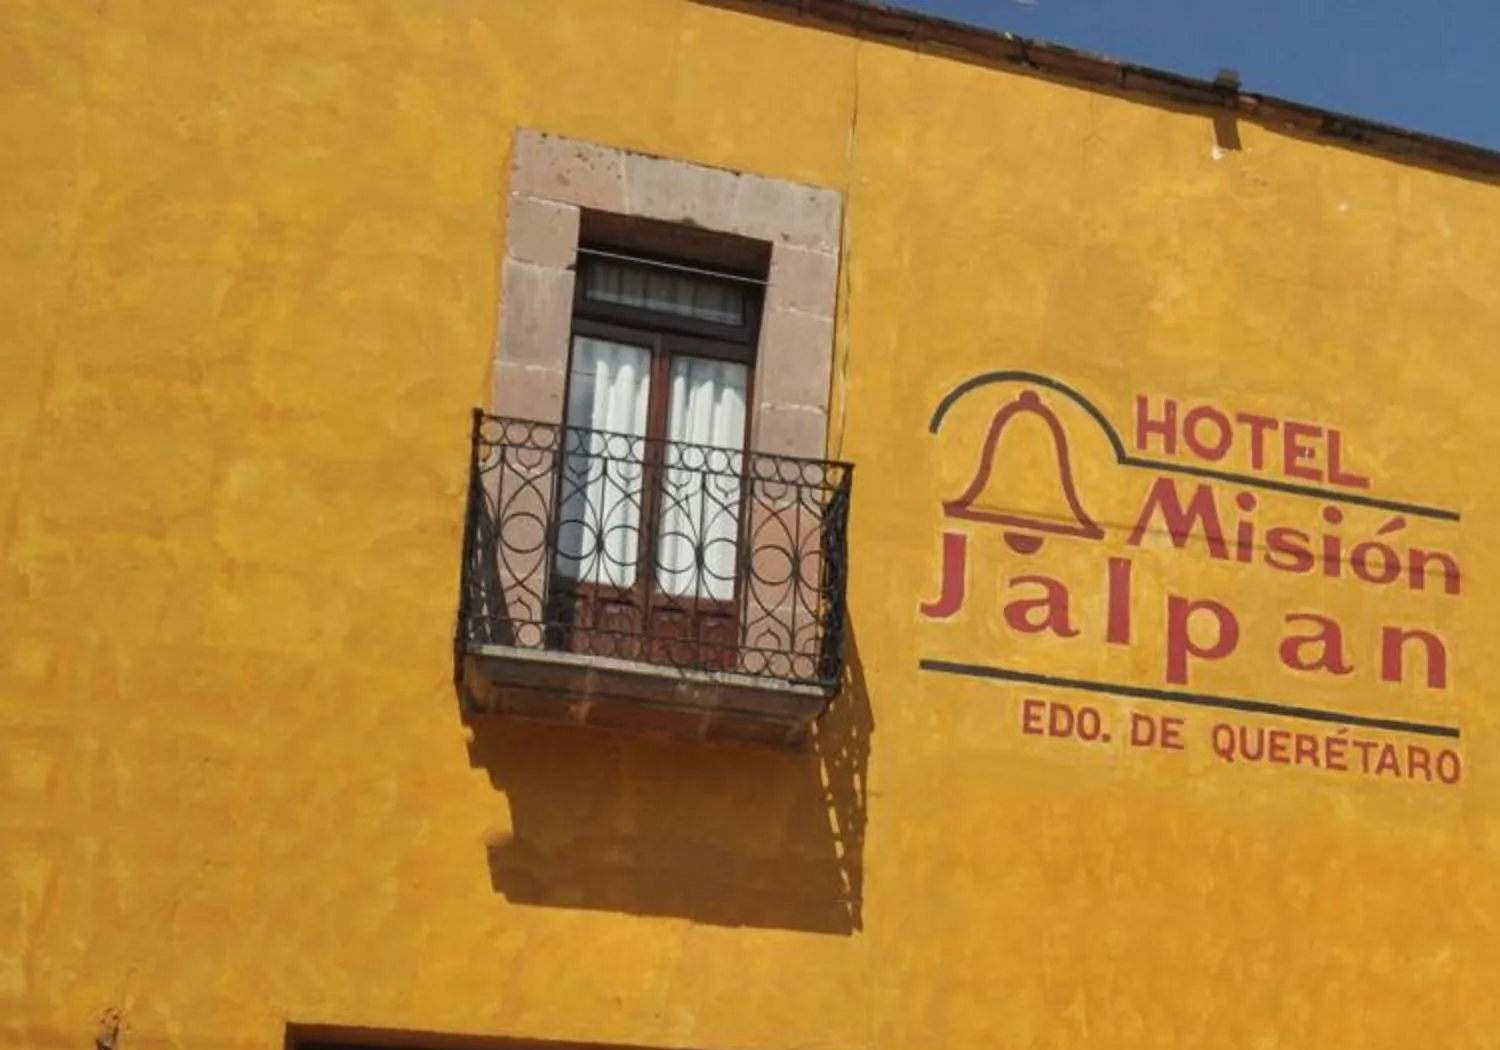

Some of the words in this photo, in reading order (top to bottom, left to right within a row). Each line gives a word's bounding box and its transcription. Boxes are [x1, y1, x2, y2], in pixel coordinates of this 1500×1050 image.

[1135, 393, 1371, 489] HOTEL
[1126, 476, 1462, 596] Misión
[919, 531, 1447, 689] Jalpan
[1021, 699, 1112, 744] EDO.
[1129, 710, 1185, 751] DE
[1211, 722, 1462, 785] QUERÉTARO
